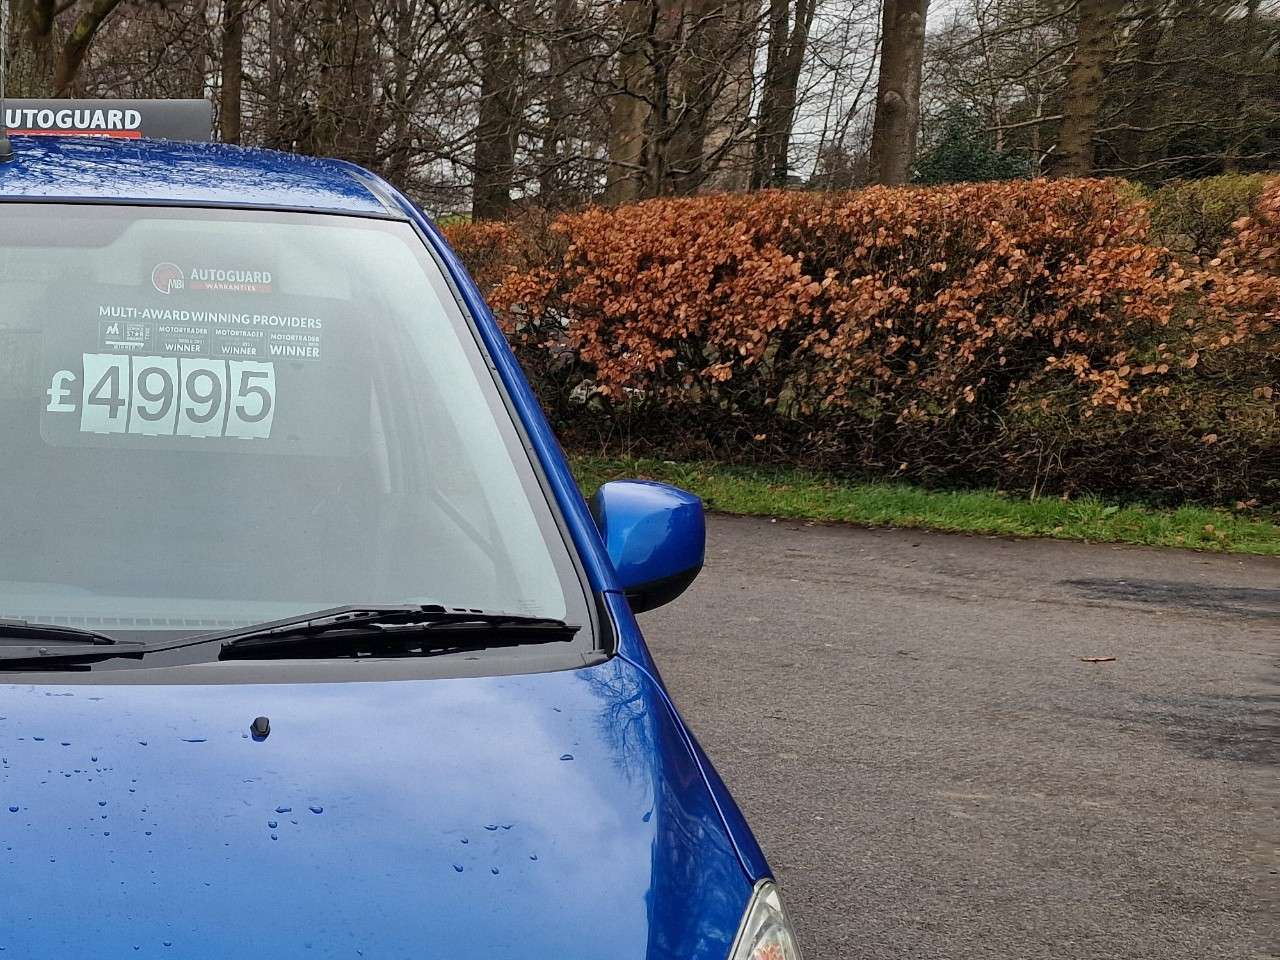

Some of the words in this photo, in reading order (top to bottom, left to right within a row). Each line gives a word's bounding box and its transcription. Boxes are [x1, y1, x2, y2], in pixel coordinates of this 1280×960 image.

[190, 268, 271, 284] AUTOGUARD
[99, 305, 190, 321] MULTI-AWARD
[191, 311, 250, 325] WINNING
[253, 314, 322, 329] PROVIDERS
[165, 343, 201, 352] WINNER
[221, 345, 257, 355] WINNER
[269, 343, 320, 358] WINNER
[47, 365, 272, 424] £4995
